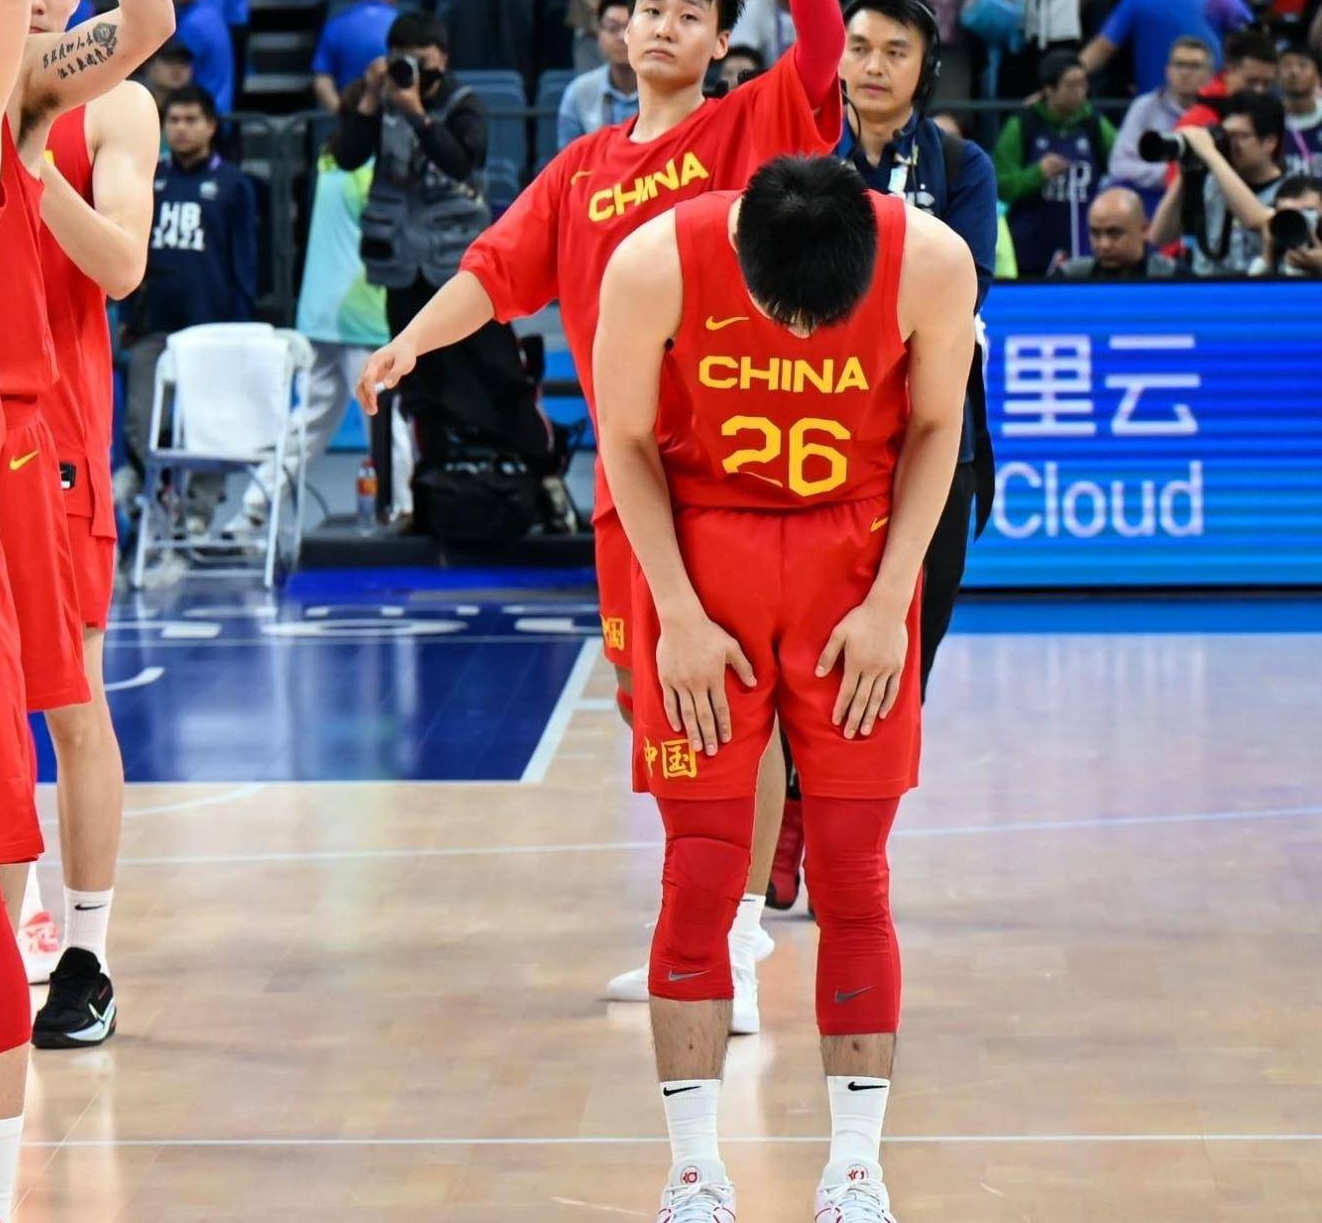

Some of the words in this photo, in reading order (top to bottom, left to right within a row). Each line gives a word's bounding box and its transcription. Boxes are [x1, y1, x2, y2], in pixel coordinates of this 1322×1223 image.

[587, 151, 710, 223] CHINA
[698, 355, 870, 394] CHINA
[989, 334, 1203, 438] 里云
[720, 414, 851, 497] 26
[993, 460, 1205, 539] Cloud
[644, 736, 698, 780] 中国
